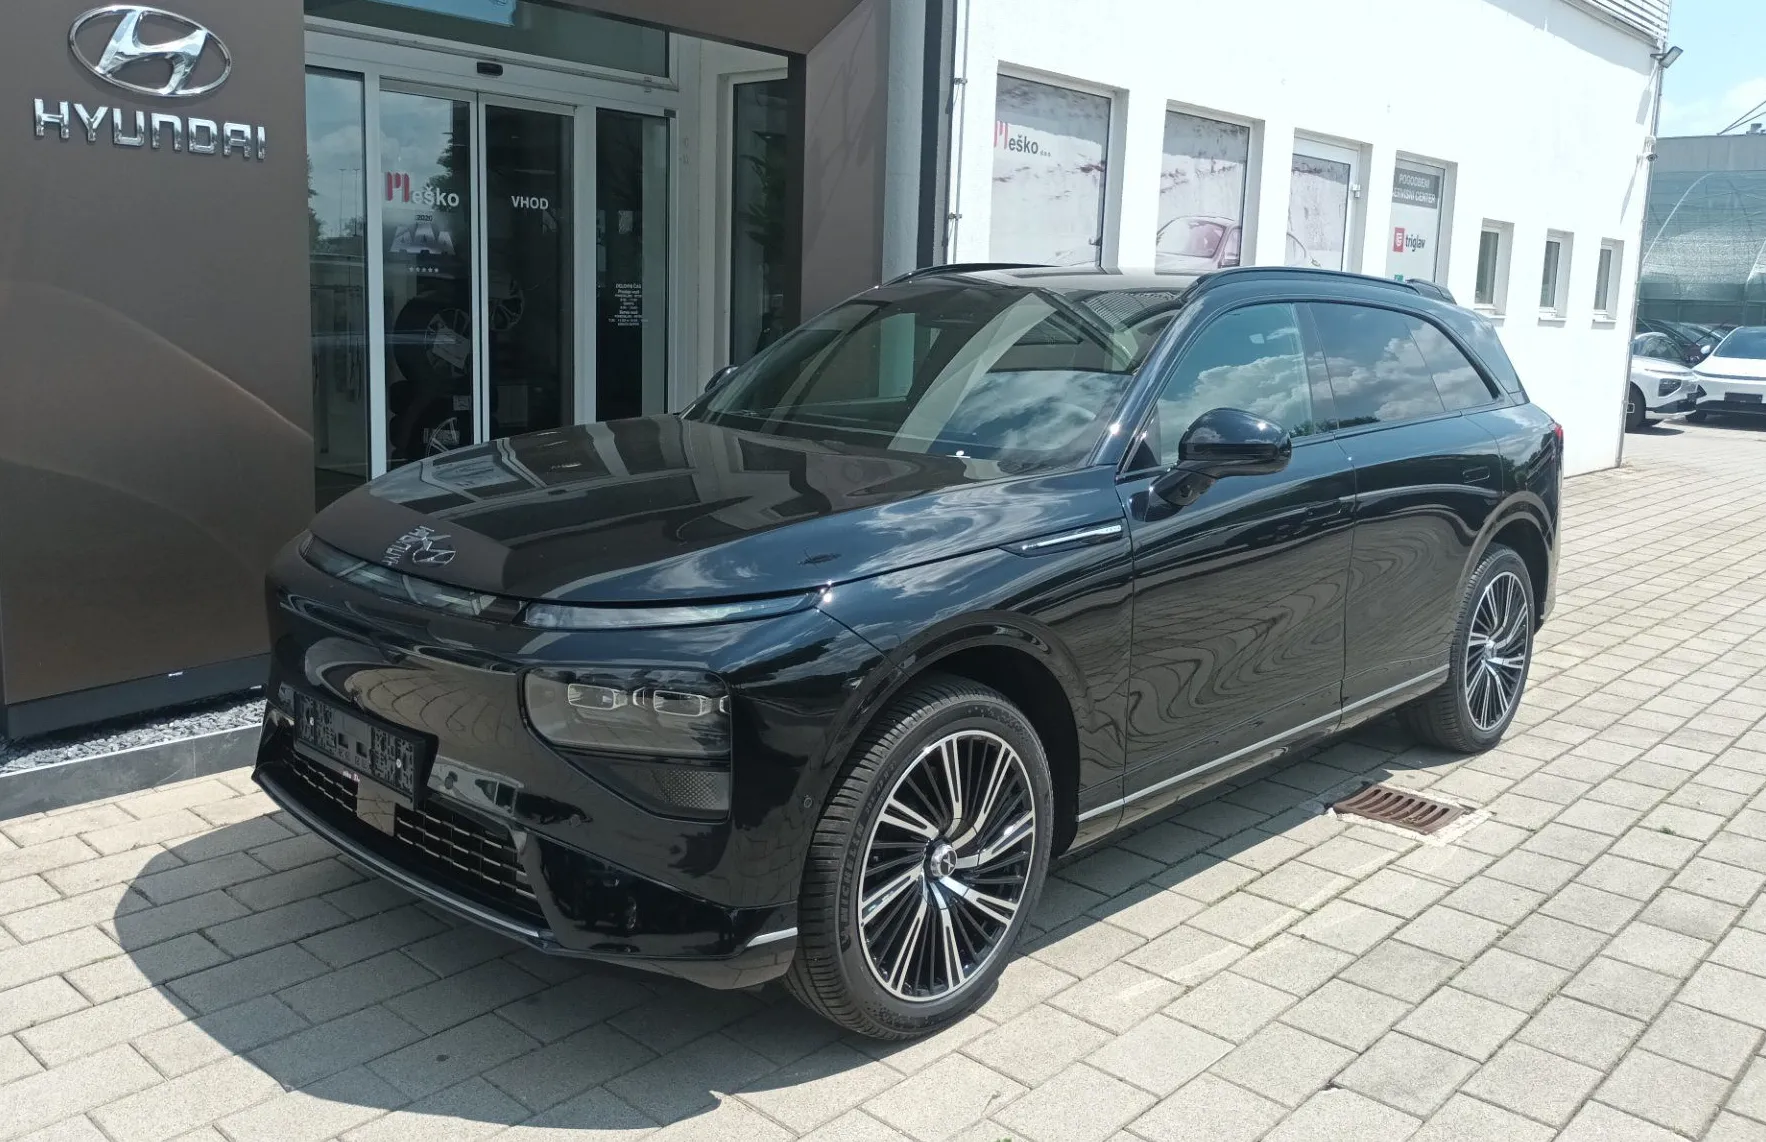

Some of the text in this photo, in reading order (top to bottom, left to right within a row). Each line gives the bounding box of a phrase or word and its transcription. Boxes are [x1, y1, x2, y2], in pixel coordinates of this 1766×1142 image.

[34, 98, 266, 160] HYUNDAI
[511, 195, 549, 210] VHOD
[1405, 234, 1426, 252] triglav
